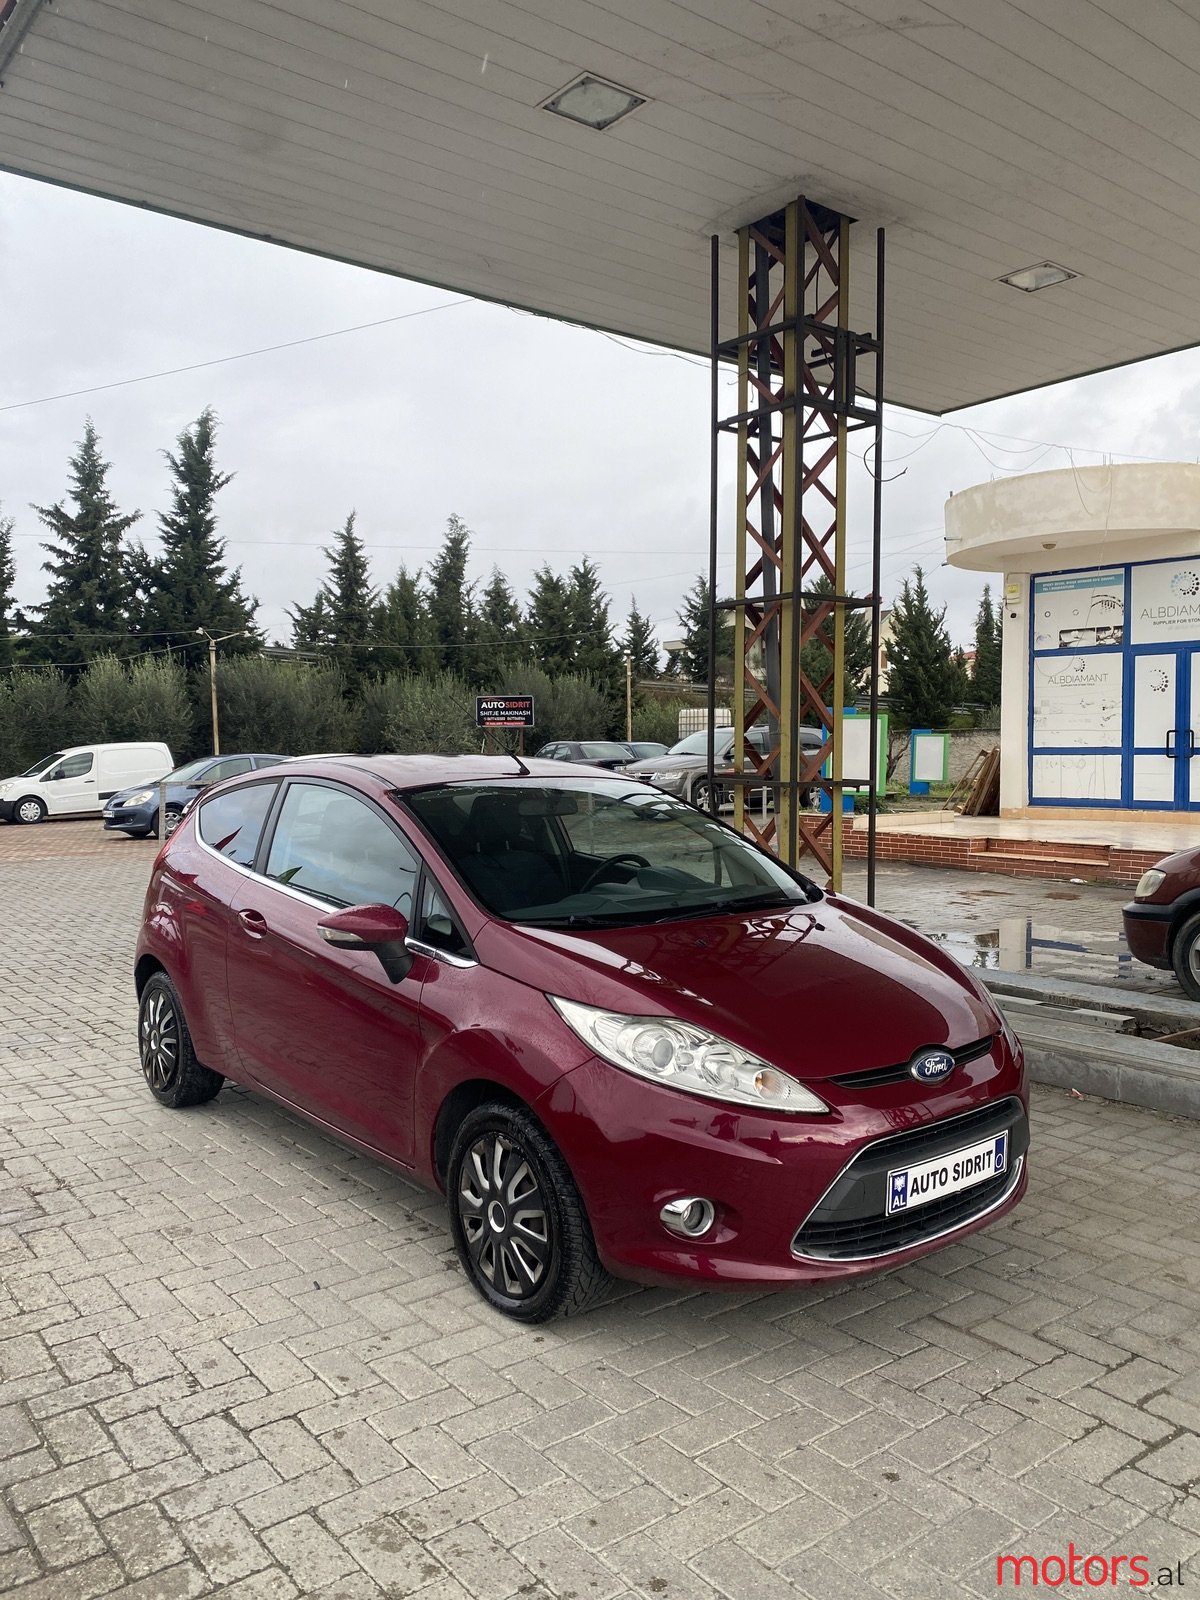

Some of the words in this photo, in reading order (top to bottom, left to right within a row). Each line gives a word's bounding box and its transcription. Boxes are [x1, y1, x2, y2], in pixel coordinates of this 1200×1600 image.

[1048, 673, 1108, 684] ALBDIAMANT
[924, 1057, 948, 1075] Ford
[910, 1167, 947, 1197] AUTO
[953, 1149, 994, 1182] SIDRIT
[892, 1195, 906, 1208] AL
